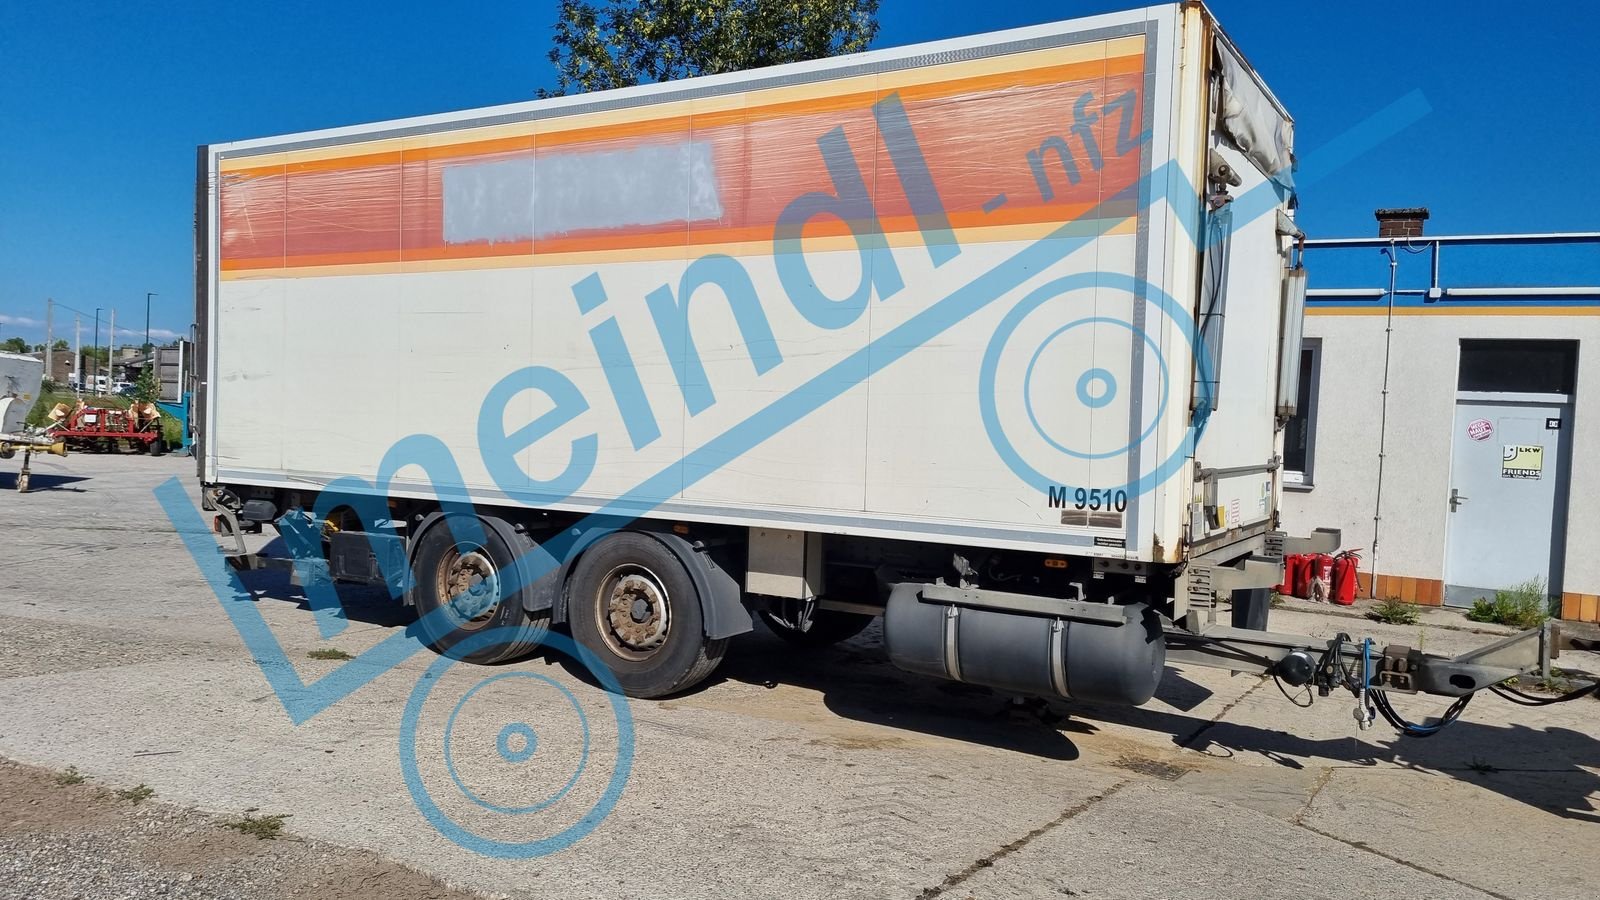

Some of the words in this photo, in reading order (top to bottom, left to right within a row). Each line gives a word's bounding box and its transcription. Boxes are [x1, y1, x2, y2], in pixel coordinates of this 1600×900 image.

[1503, 469, 1541, 477] FRIENDS
[1048, 486, 1066, 509] M
[1074, 487, 1127, 513] 9510
